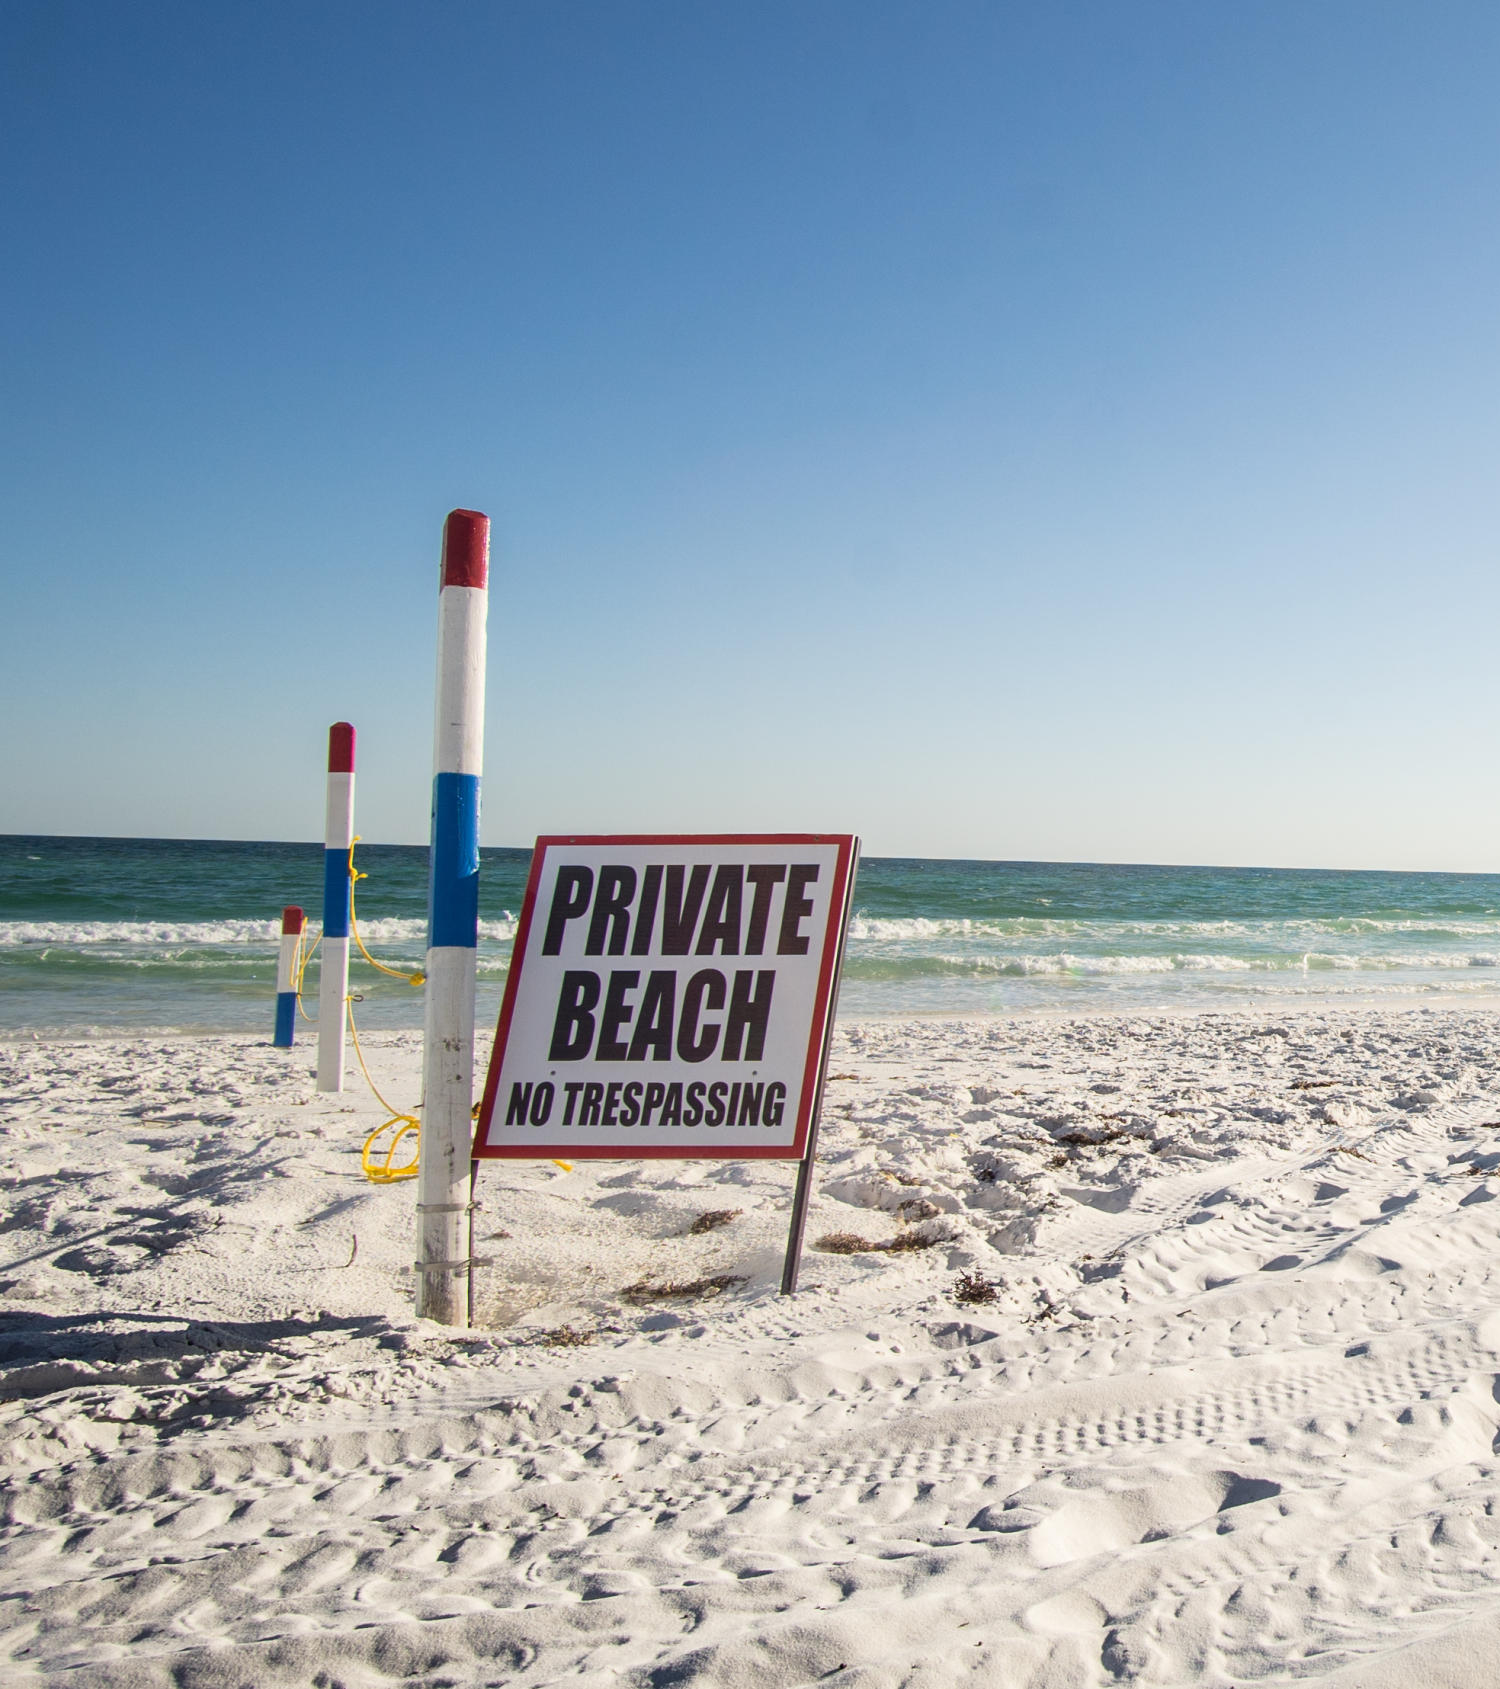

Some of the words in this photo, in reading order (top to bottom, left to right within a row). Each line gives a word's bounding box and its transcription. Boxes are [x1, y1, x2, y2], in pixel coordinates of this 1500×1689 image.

[541, 863, 821, 957] PRIVATE
[547, 968, 777, 1064] BEACH
[504, 1081, 556, 1127] NO
[561, 1081, 787, 1128] TRESPASSING
